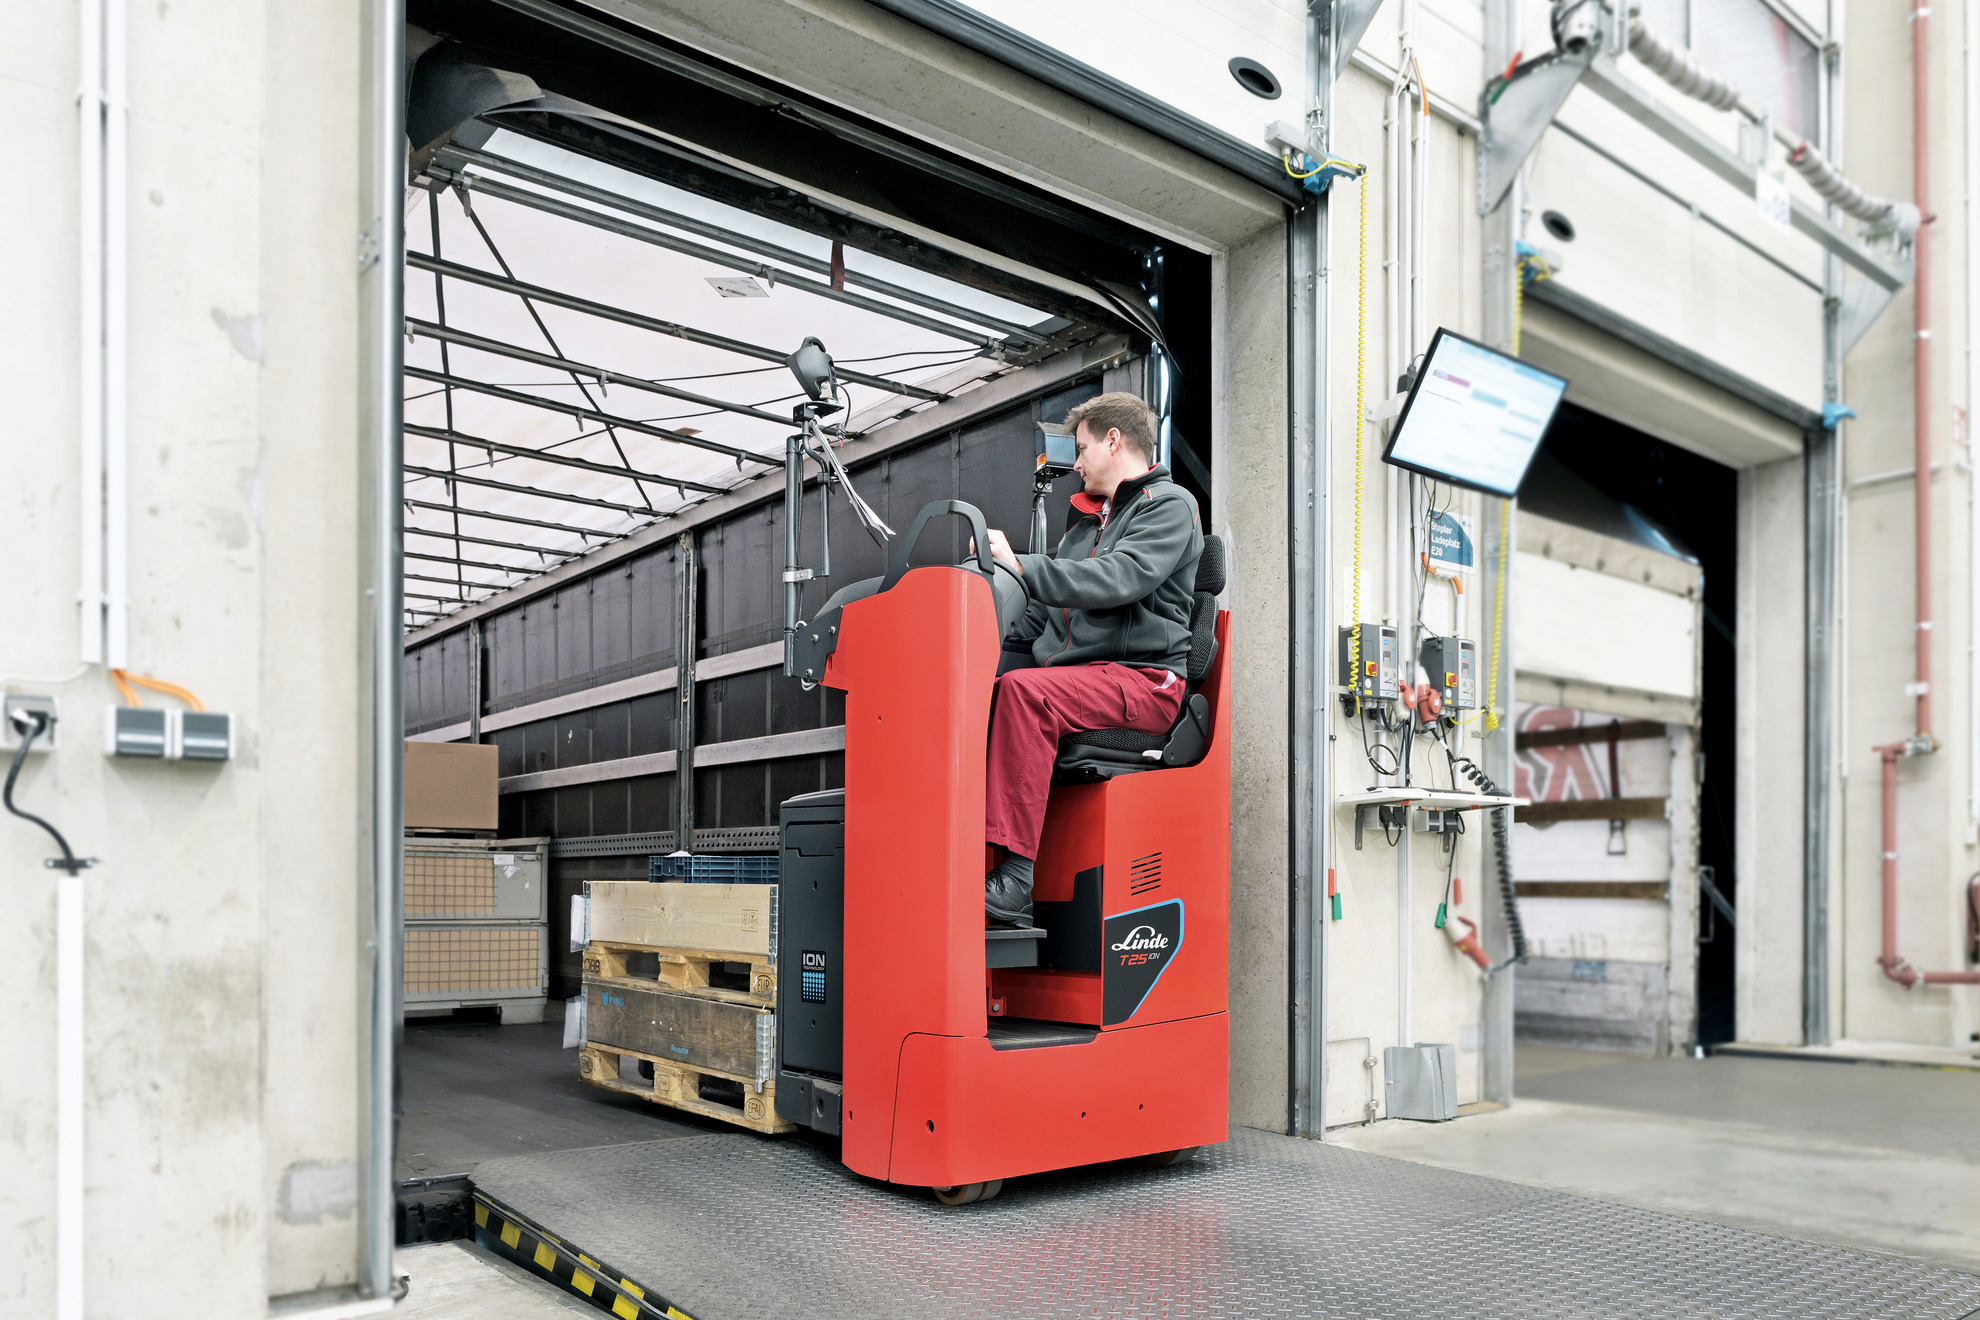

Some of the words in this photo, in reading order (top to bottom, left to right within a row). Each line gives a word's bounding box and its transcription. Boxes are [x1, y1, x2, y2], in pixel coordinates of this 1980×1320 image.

[1431, 521, 1453, 535] Stapler
[1431, 533, 1461, 549] Ladeplatz
[1431, 546, 1443, 557] E20
[1111, 925, 1169, 951] Linde
[803, 953, 825, 967] ION
[1120, 953, 1149, 966] T25
[1148, 952, 1161, 960] ION
[757, 977, 770, 994] EUR
[748, 1101, 763, 1117] EPAL
